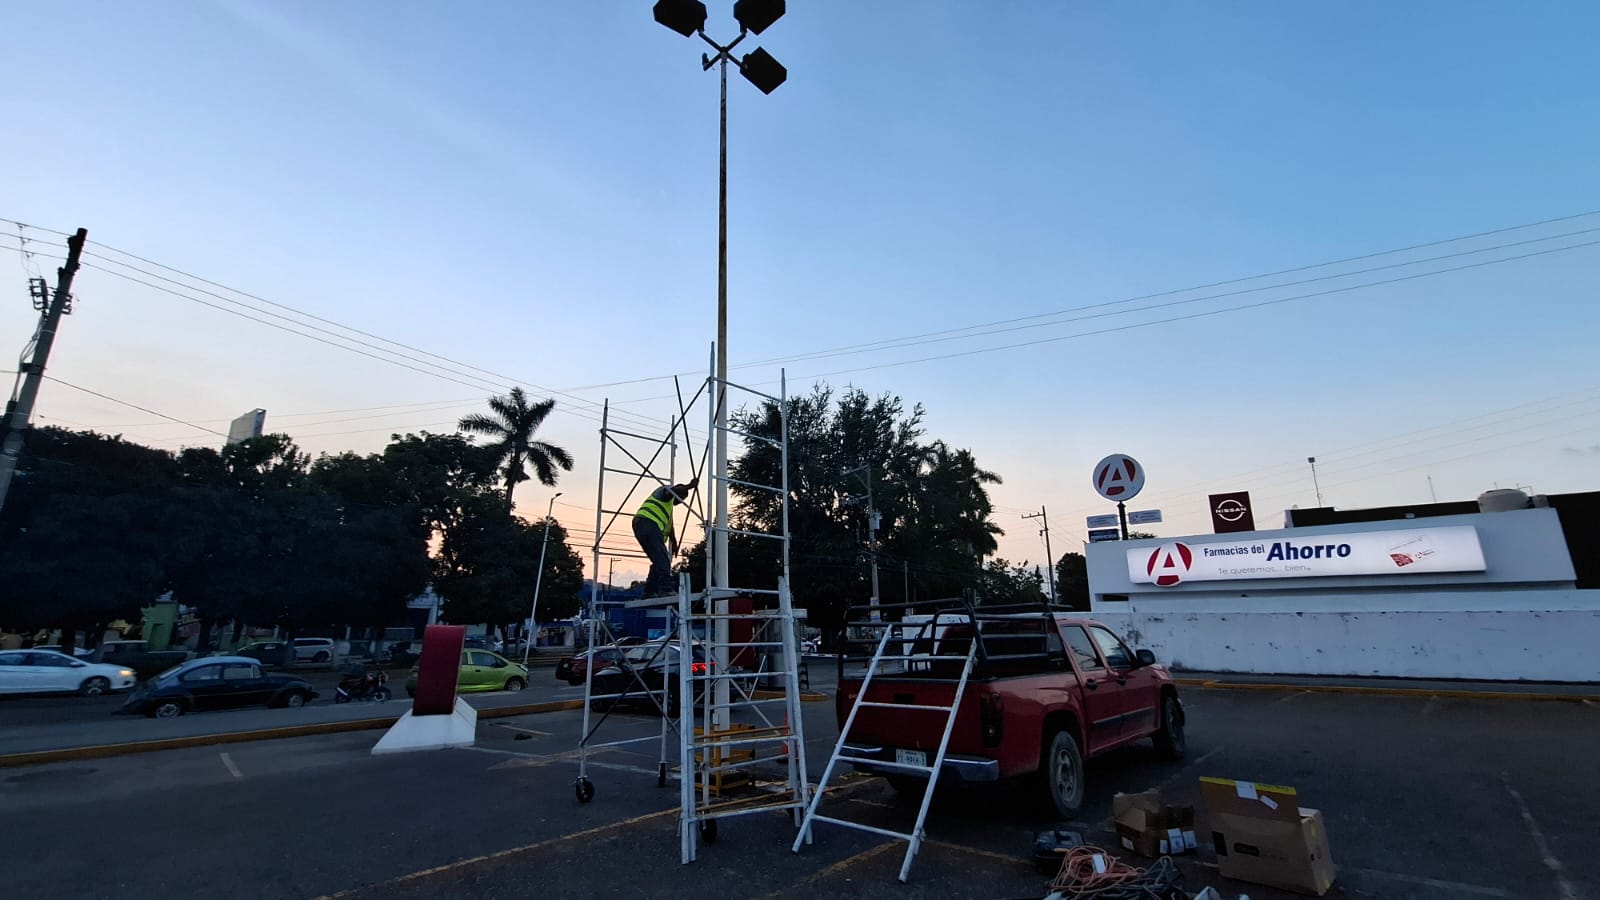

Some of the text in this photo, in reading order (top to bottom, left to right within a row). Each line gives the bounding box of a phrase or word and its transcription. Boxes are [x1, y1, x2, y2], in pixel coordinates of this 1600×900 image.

[1098, 458, 1137, 497] A
[1147, 542, 1192, 585] A
[1204, 542, 1351, 561] Farmacias del Ahorro
[1218, 566, 1228, 575] Te
